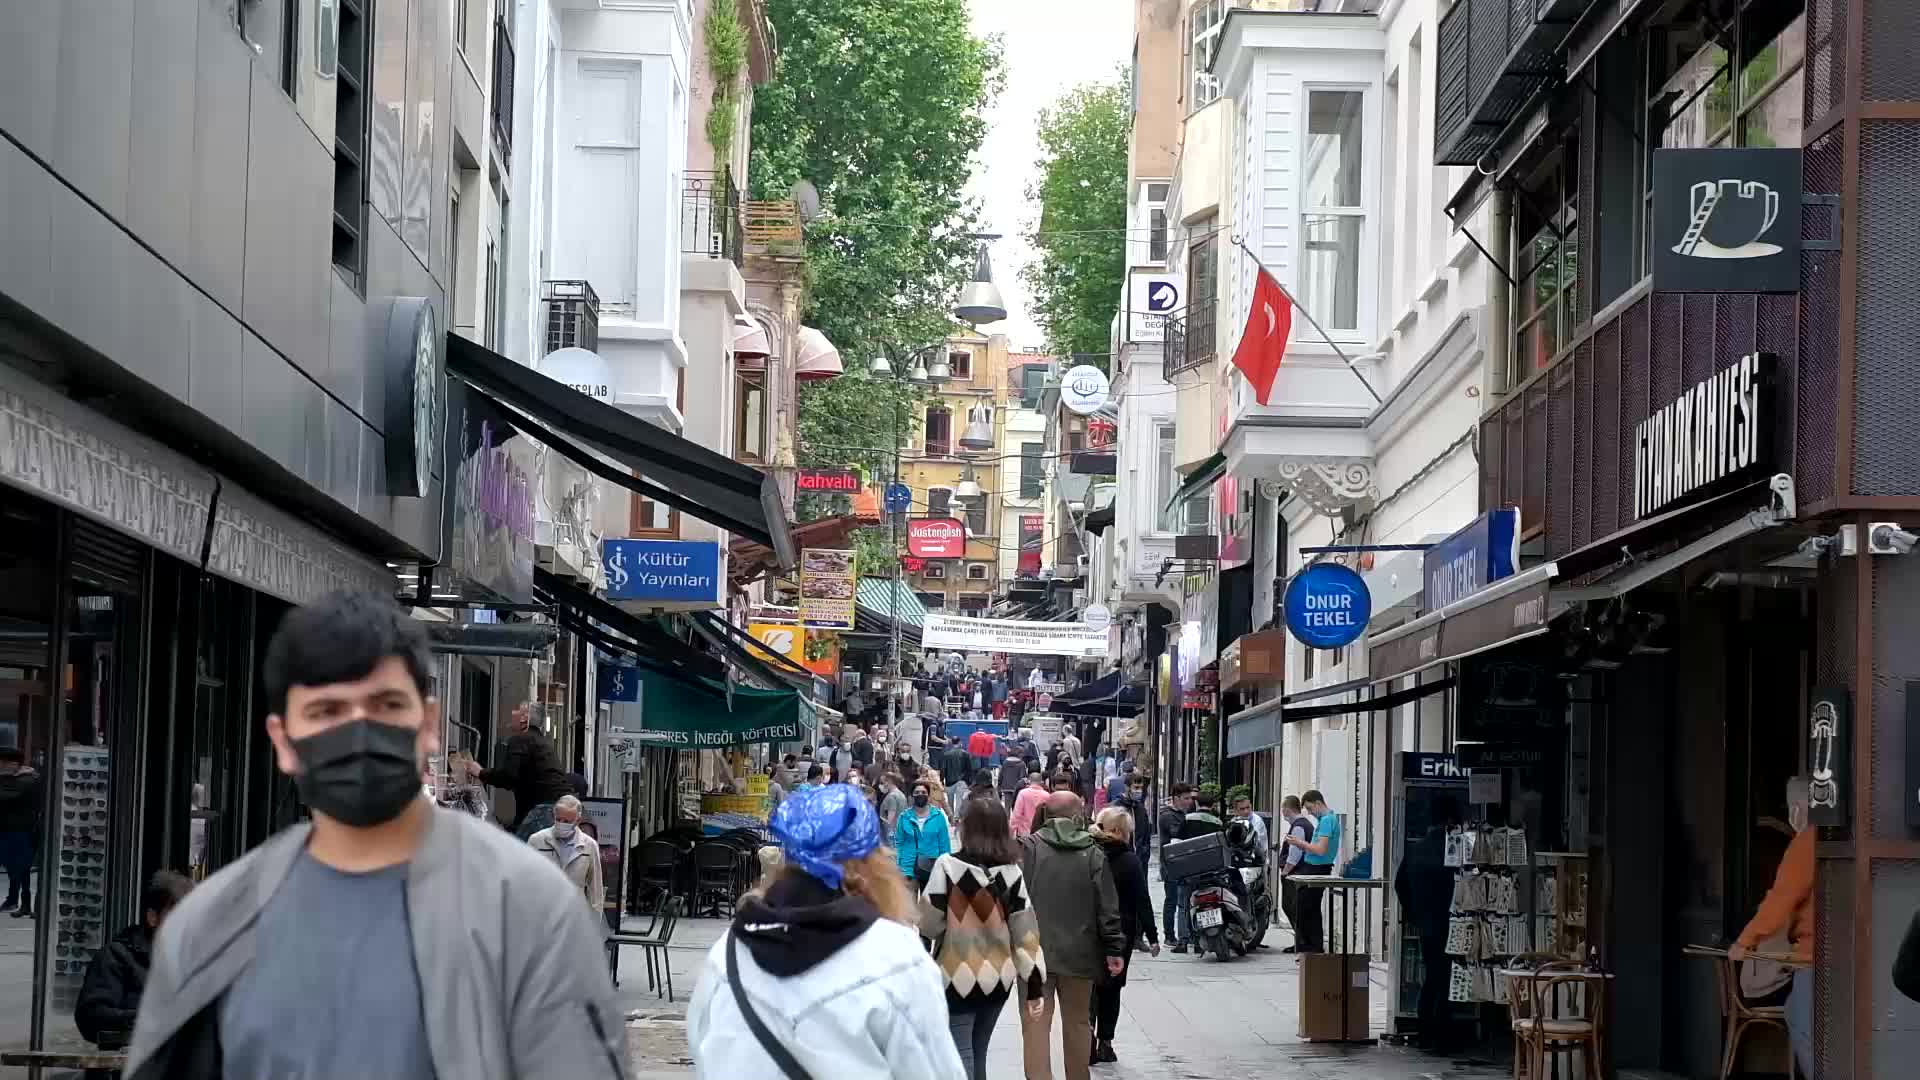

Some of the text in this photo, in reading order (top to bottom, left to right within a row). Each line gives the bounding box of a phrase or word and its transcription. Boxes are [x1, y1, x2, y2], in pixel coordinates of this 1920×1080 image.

[798, 471, 857, 489] kahvaltı
[638, 551, 691, 567] Kültür
[639, 572, 710, 589] Yayınları
[1305, 579, 1352, 609] ONUR
[1303, 611, 1356, 627] TEKEL
[641, 724, 797, 745] PRES İNEGÖL KÖFTECİSİ
